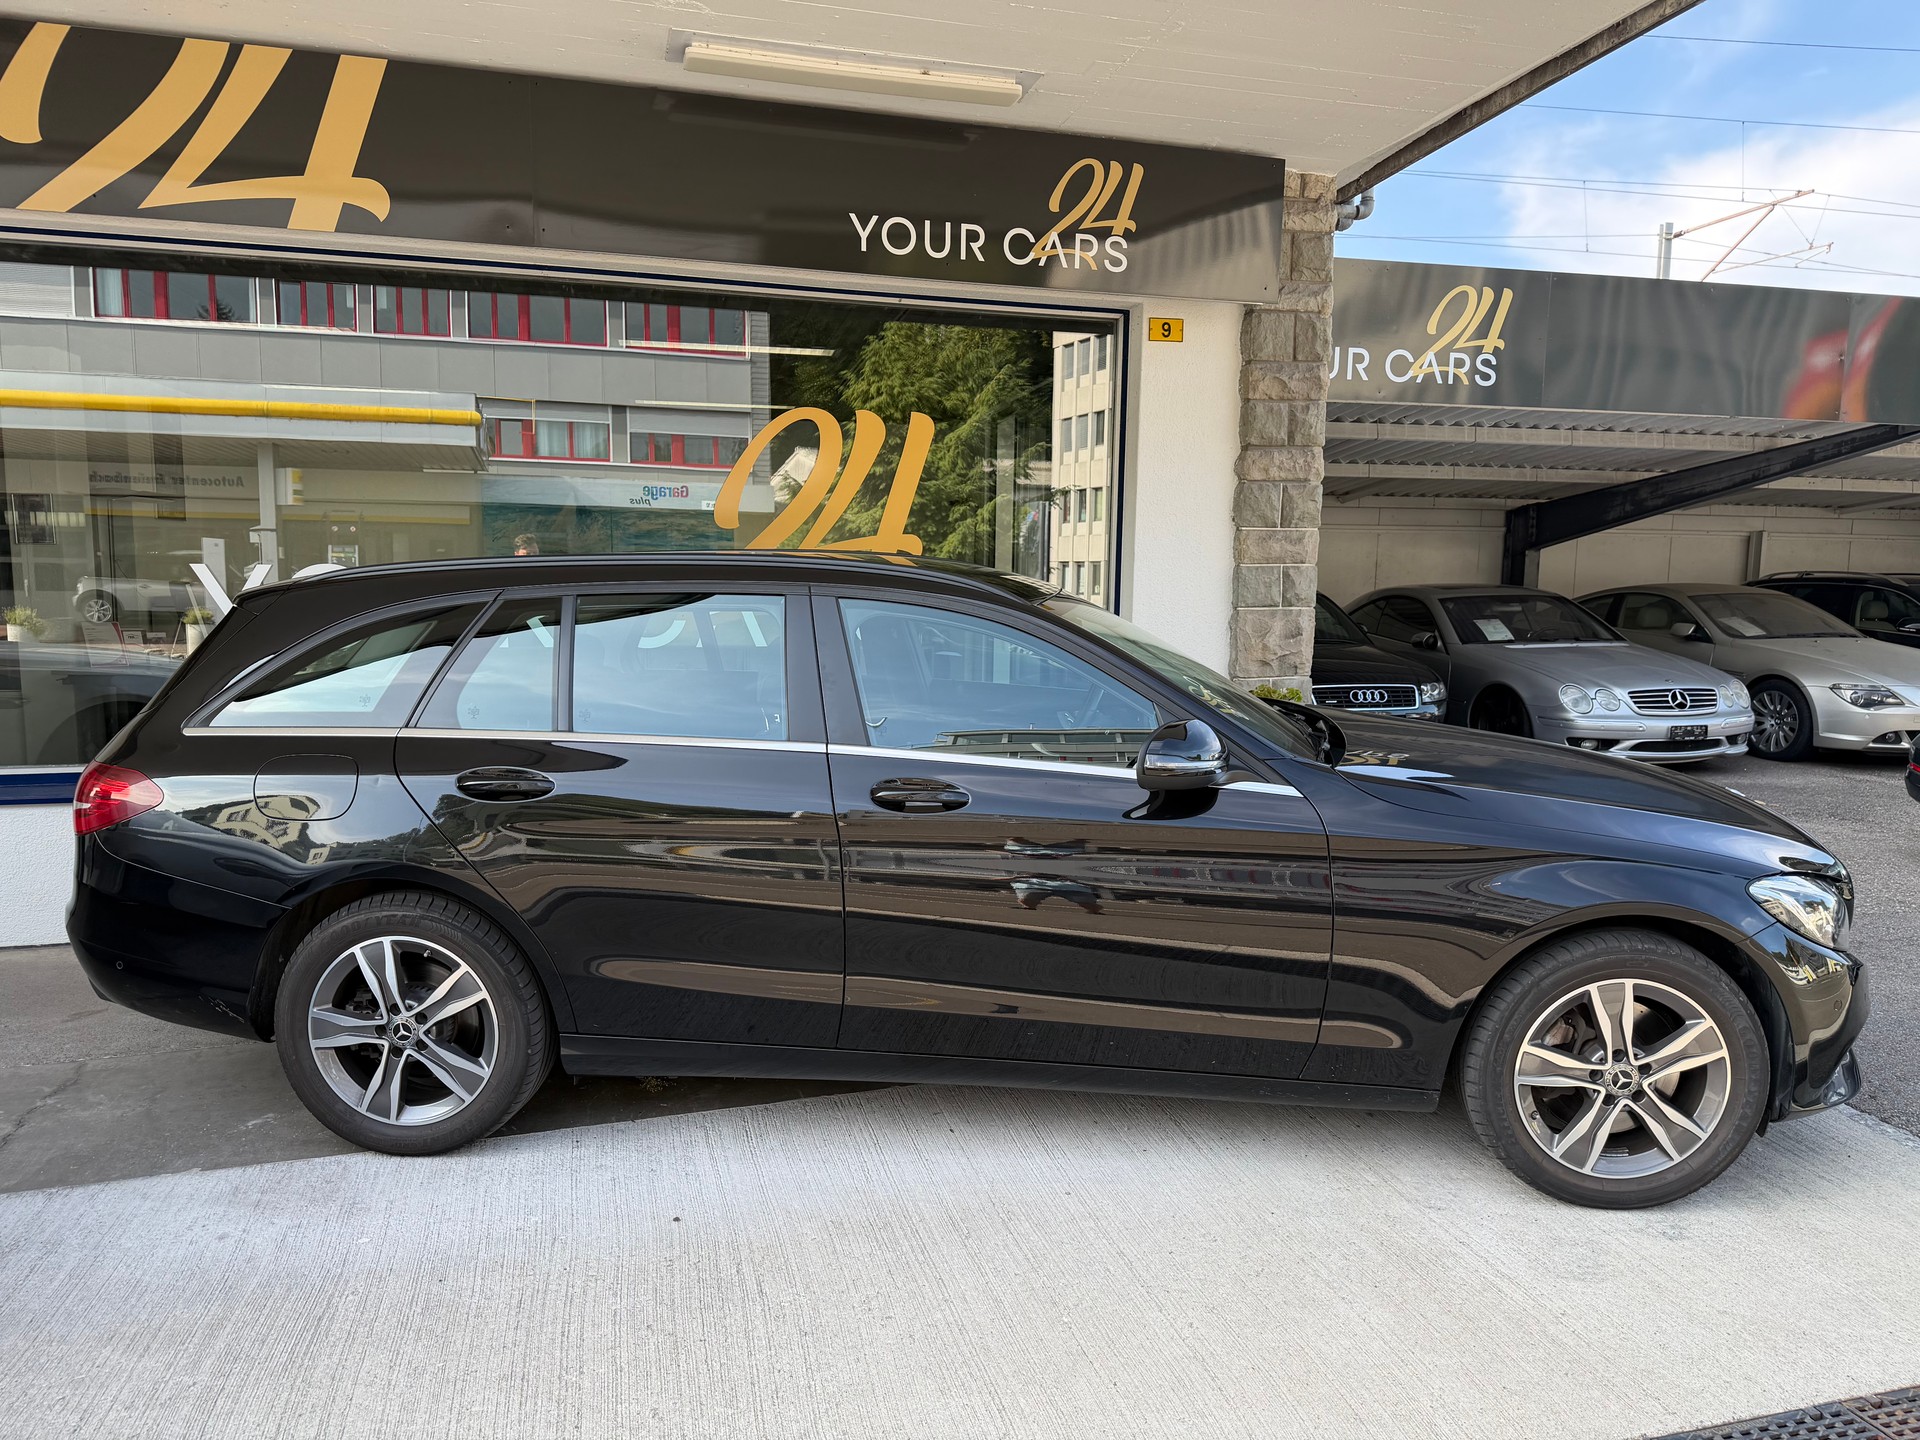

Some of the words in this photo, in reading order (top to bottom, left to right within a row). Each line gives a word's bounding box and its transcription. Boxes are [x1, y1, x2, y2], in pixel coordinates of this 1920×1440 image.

[0, 22, 390, 232] 24
[848, 213, 985, 263] YOUR
[1003, 228, 1128, 273] CARS
[1032, 158, 1144, 268] 24
[1161, 321, 1171, 339] 9
[1385, 349, 1497, 387] CARS
[1411, 285, 1513, 384] 24
[714, 407, 936, 555] 24
